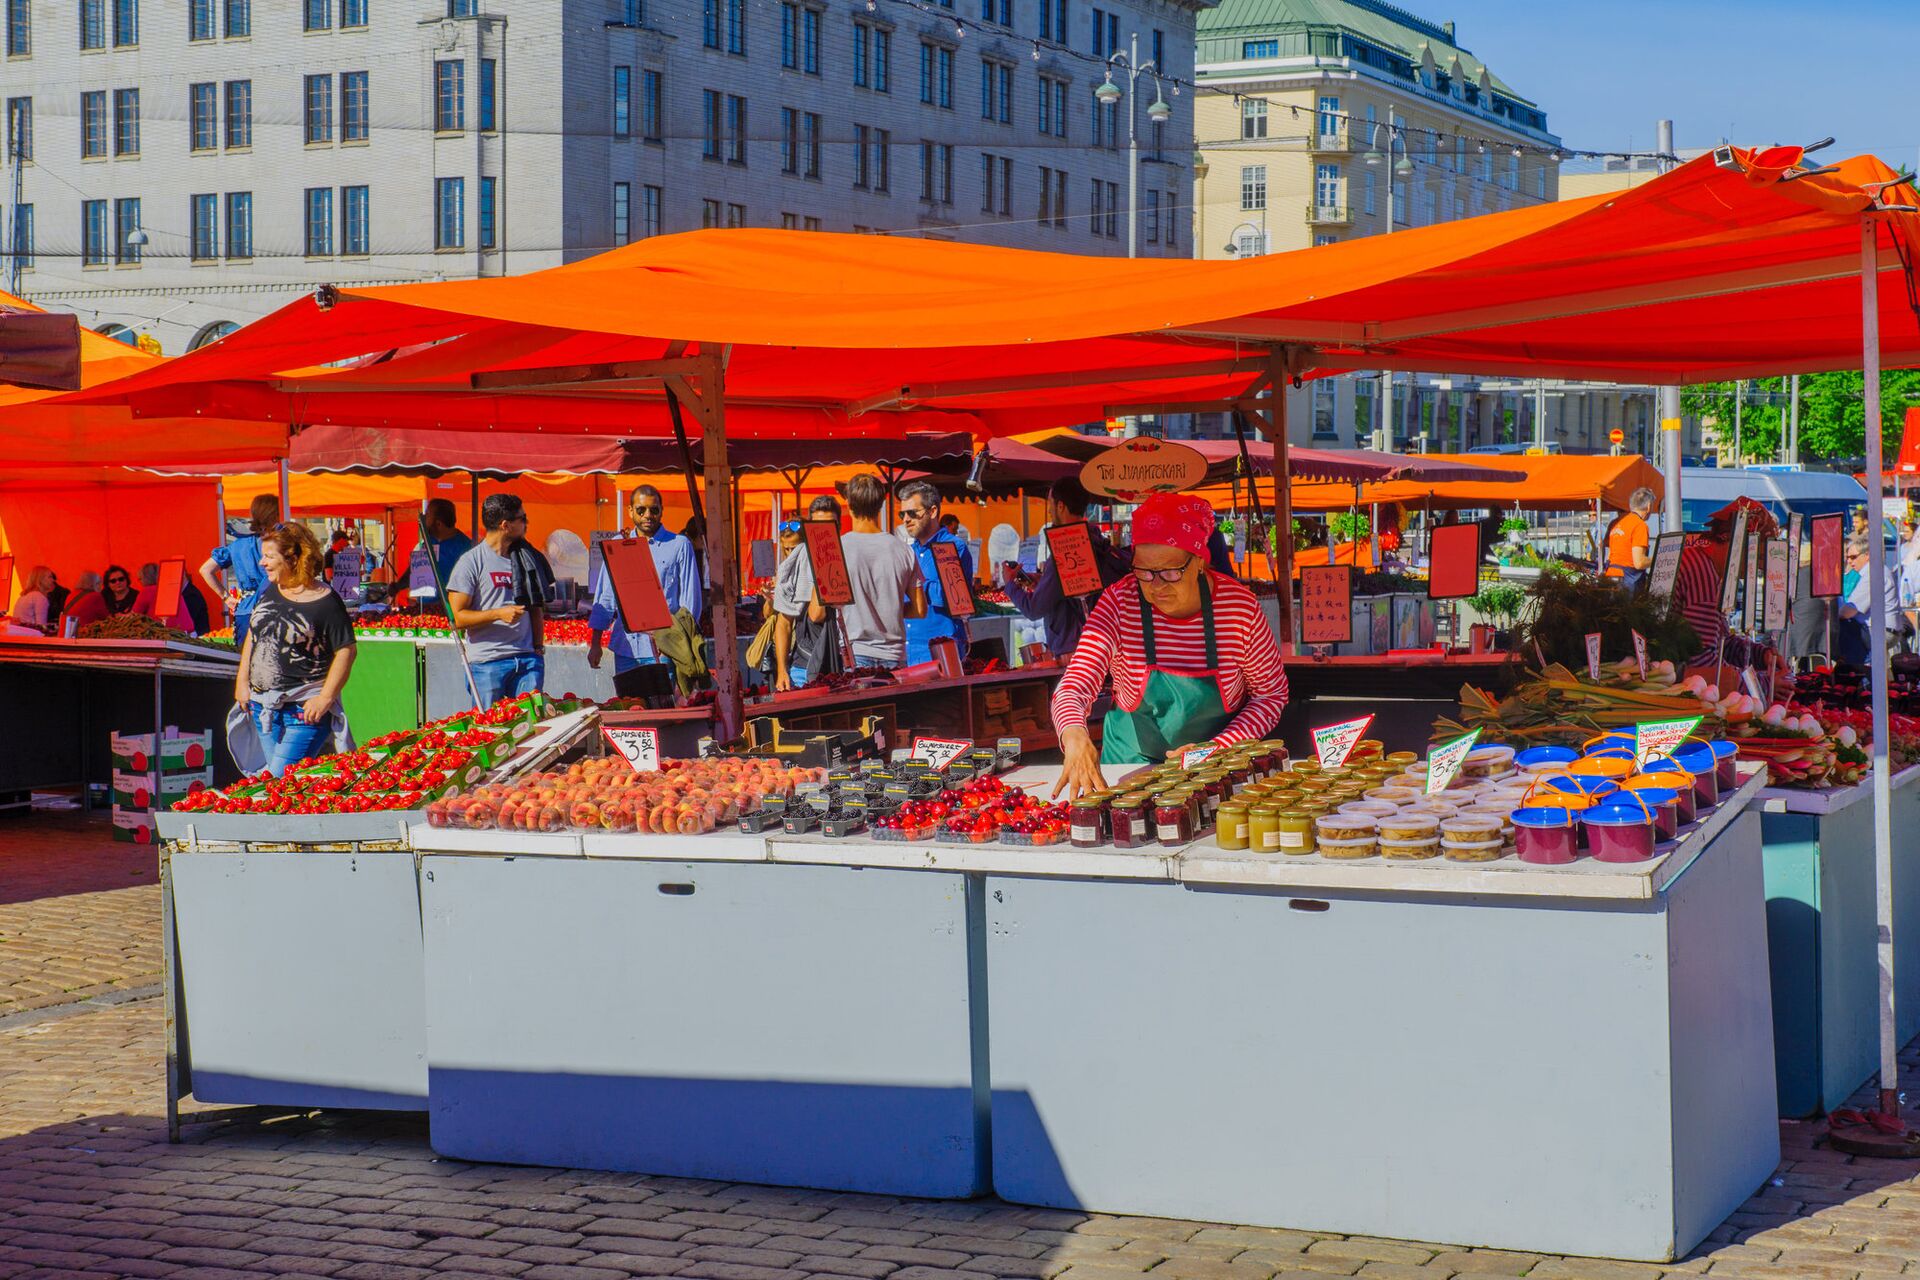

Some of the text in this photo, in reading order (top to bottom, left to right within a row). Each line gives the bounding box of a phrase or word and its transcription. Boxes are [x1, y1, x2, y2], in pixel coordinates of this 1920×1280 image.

[625, 738, 653, 762] 3 50
[926, 749, 937, 770] 3
[1323, 746, 1337, 764] 2
[1433, 762, 1445, 778] 3
